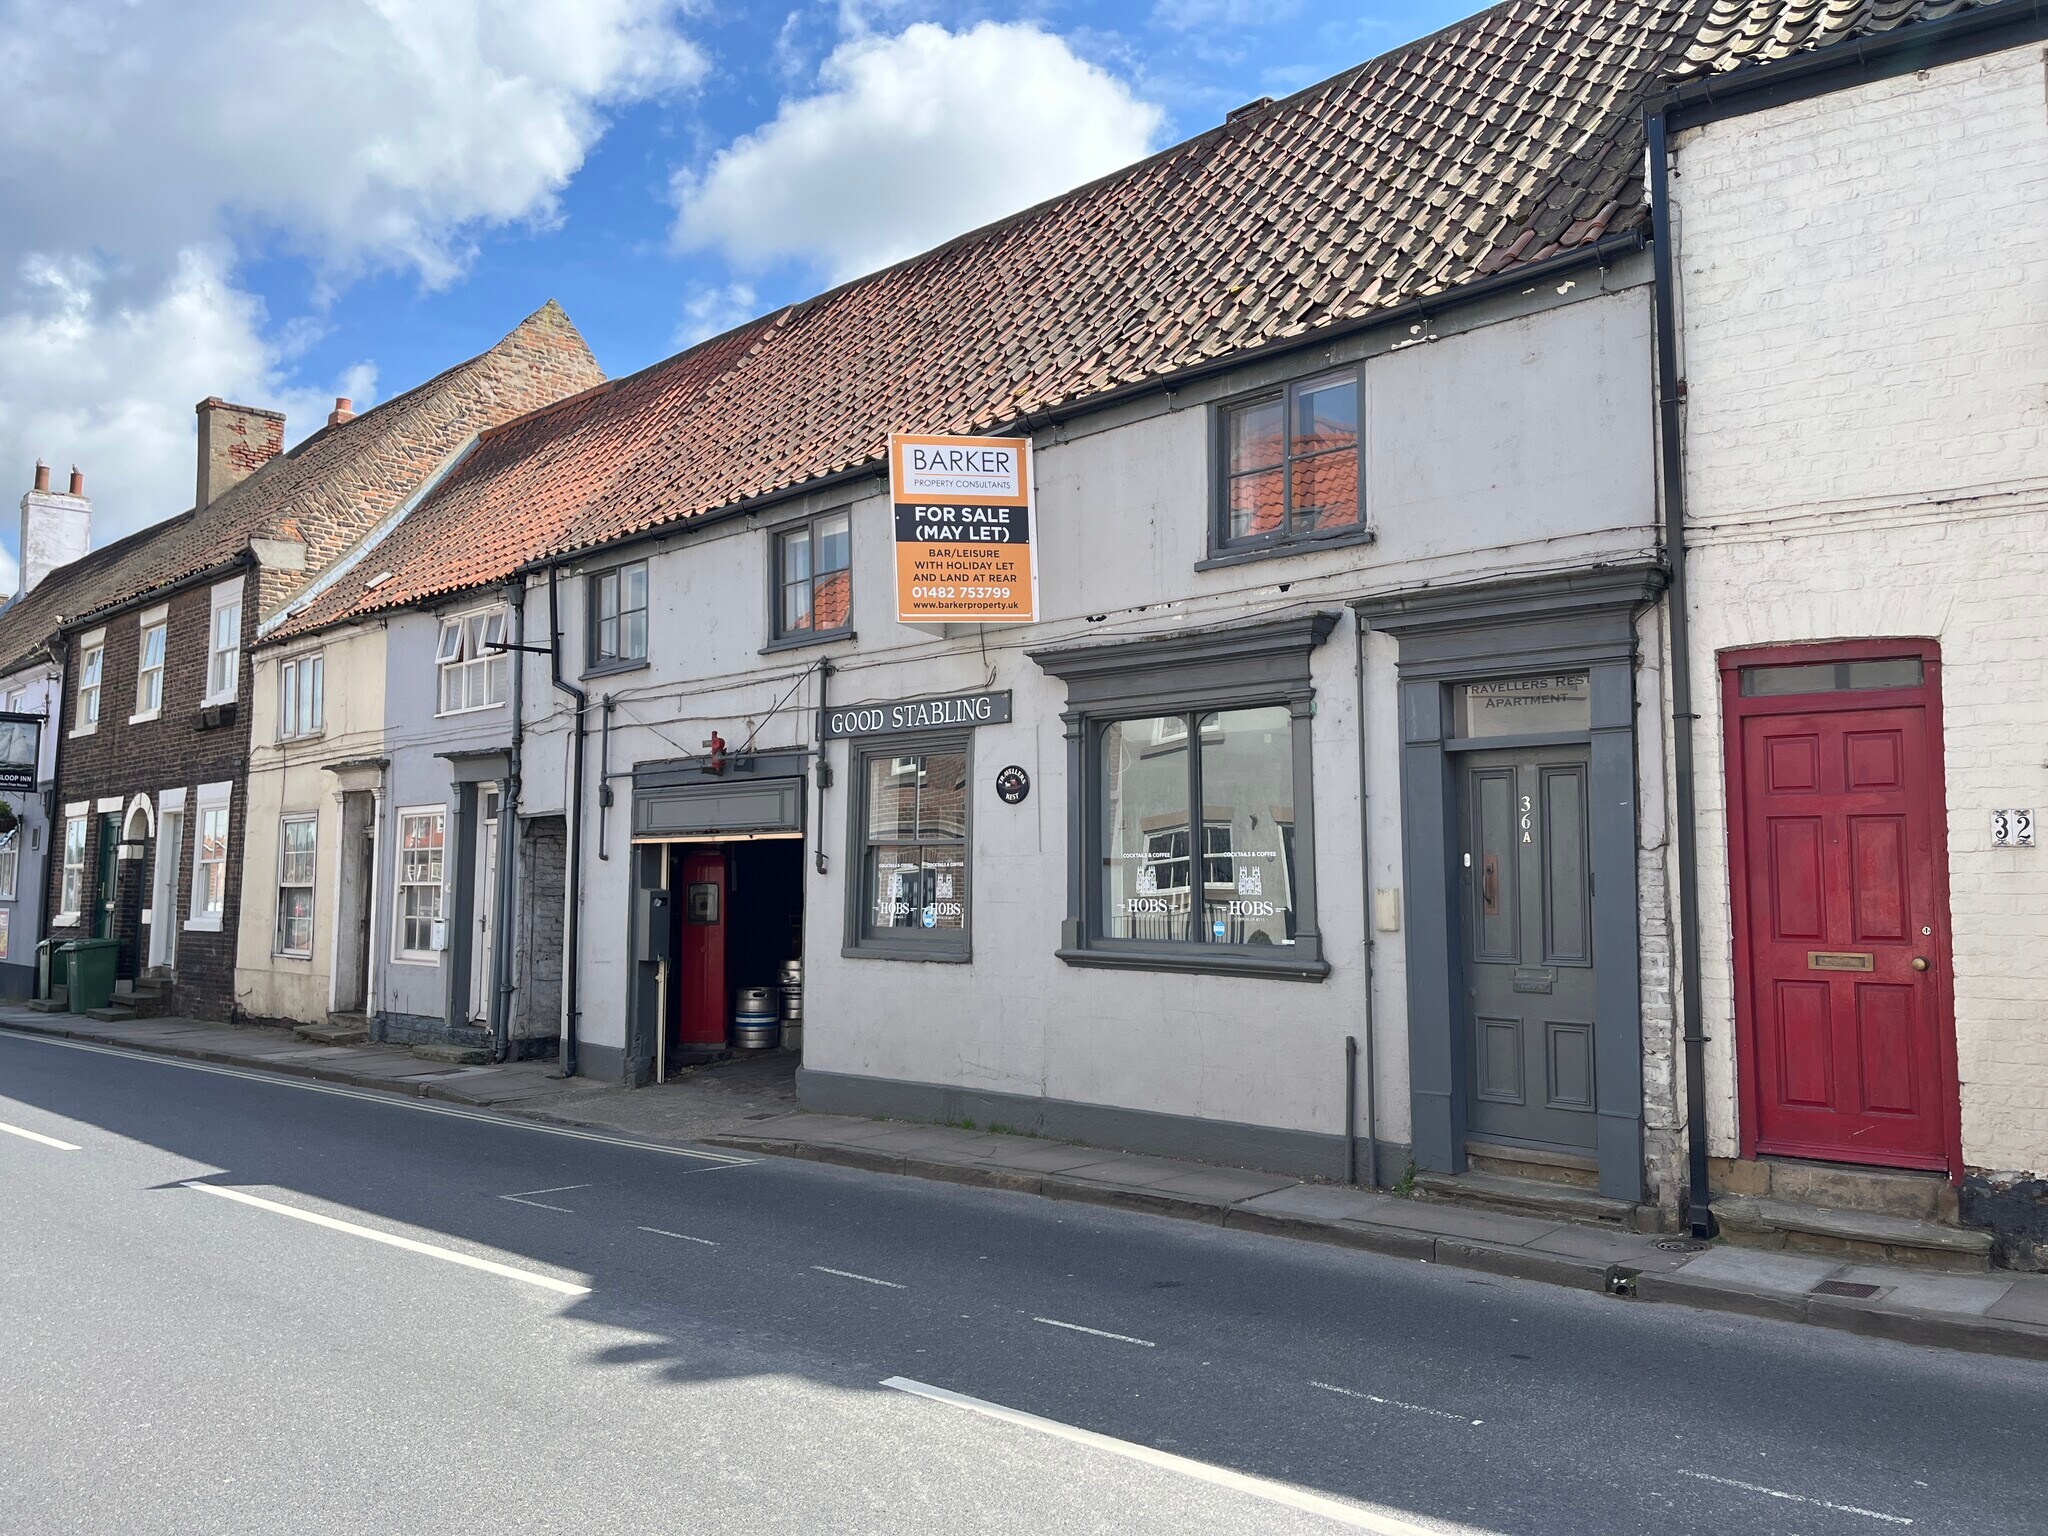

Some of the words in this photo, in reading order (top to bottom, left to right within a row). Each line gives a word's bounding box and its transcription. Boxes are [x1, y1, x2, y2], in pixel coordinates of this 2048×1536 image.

[914, 449, 1010, 473] BARKER
[914, 479, 954, 488] PROPERTY
[955, 480, 1011, 490] CONSULTANTS
[914, 506, 956, 522] FOR
[961, 507, 1010, 523] SALE
[915, 525, 963, 542] (MAY
[969, 526, 1010, 543] LET)
[928, 548, 1000, 559] BAR/LEISURE
[914, 561, 943, 570] WITH
[946, 561, 993, 570] HOLIDAY
[996, 562, 1015, 571] LET
[913, 573, 937, 582] AND
[940, 573, 970, 582] LAND
[972, 574, 986, 582] AT
[989, 574, 1017, 583] REAR
[912, 586, 955, 598] 01482
[959, 586, 1010, 599] 753799
[913, 601, 1019, 610] www.barkerproperty.uk
[1461, 679, 1548, 695] TRAVELLERS
[1555, 675, 1590, 687] REST
[1485, 693, 1569, 709] APARTMENT
[831, 709, 884, 733] GOOD
[892, 697, 991, 728] STABLING
[1005, 792, 1019, 801] REST
[1995, 816, 2031, 839] 32
[880, 902, 910, 915] HOBS
[929, 902, 961, 915] HOBS
[1127, 898, 1168, 913] HOBS
[1228, 900, 1274, 916] HOBS
